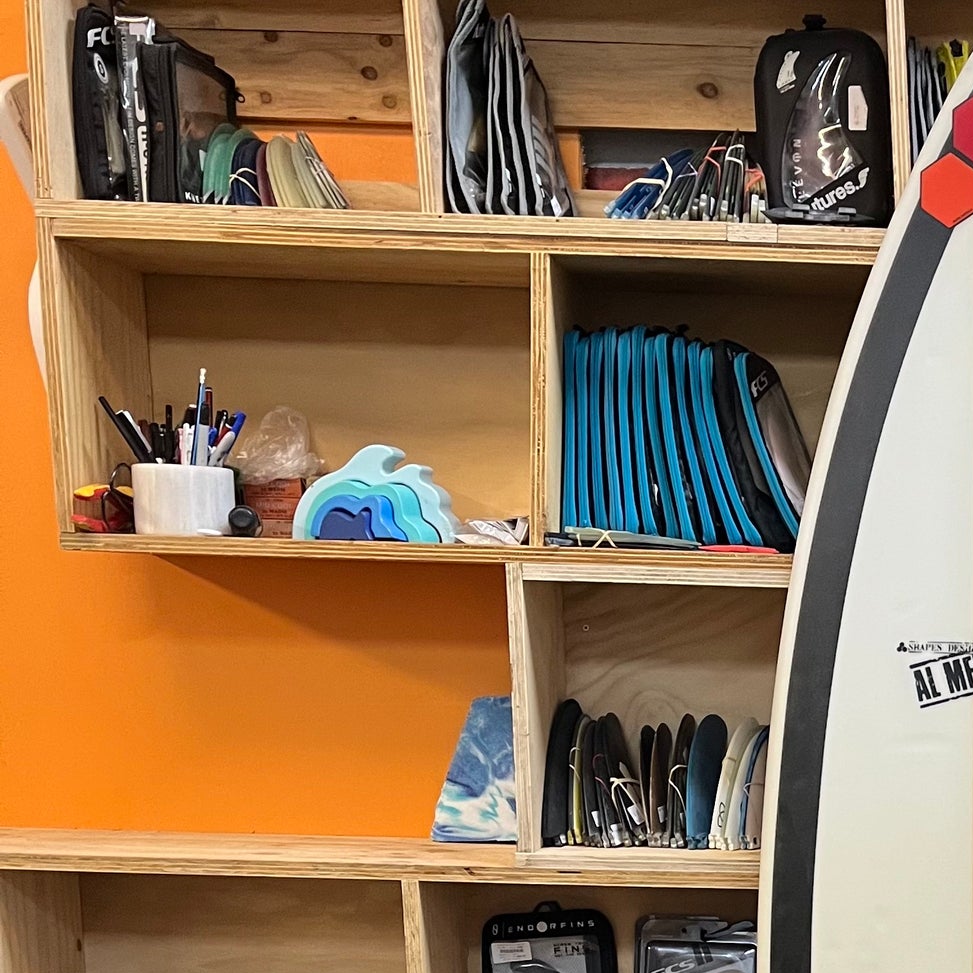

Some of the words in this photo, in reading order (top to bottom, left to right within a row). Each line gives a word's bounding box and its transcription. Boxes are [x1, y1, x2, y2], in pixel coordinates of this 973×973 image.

[87, 27, 115, 48] FC
[751, 371, 768, 399] FCS
[913, 666, 941, 702] AL
